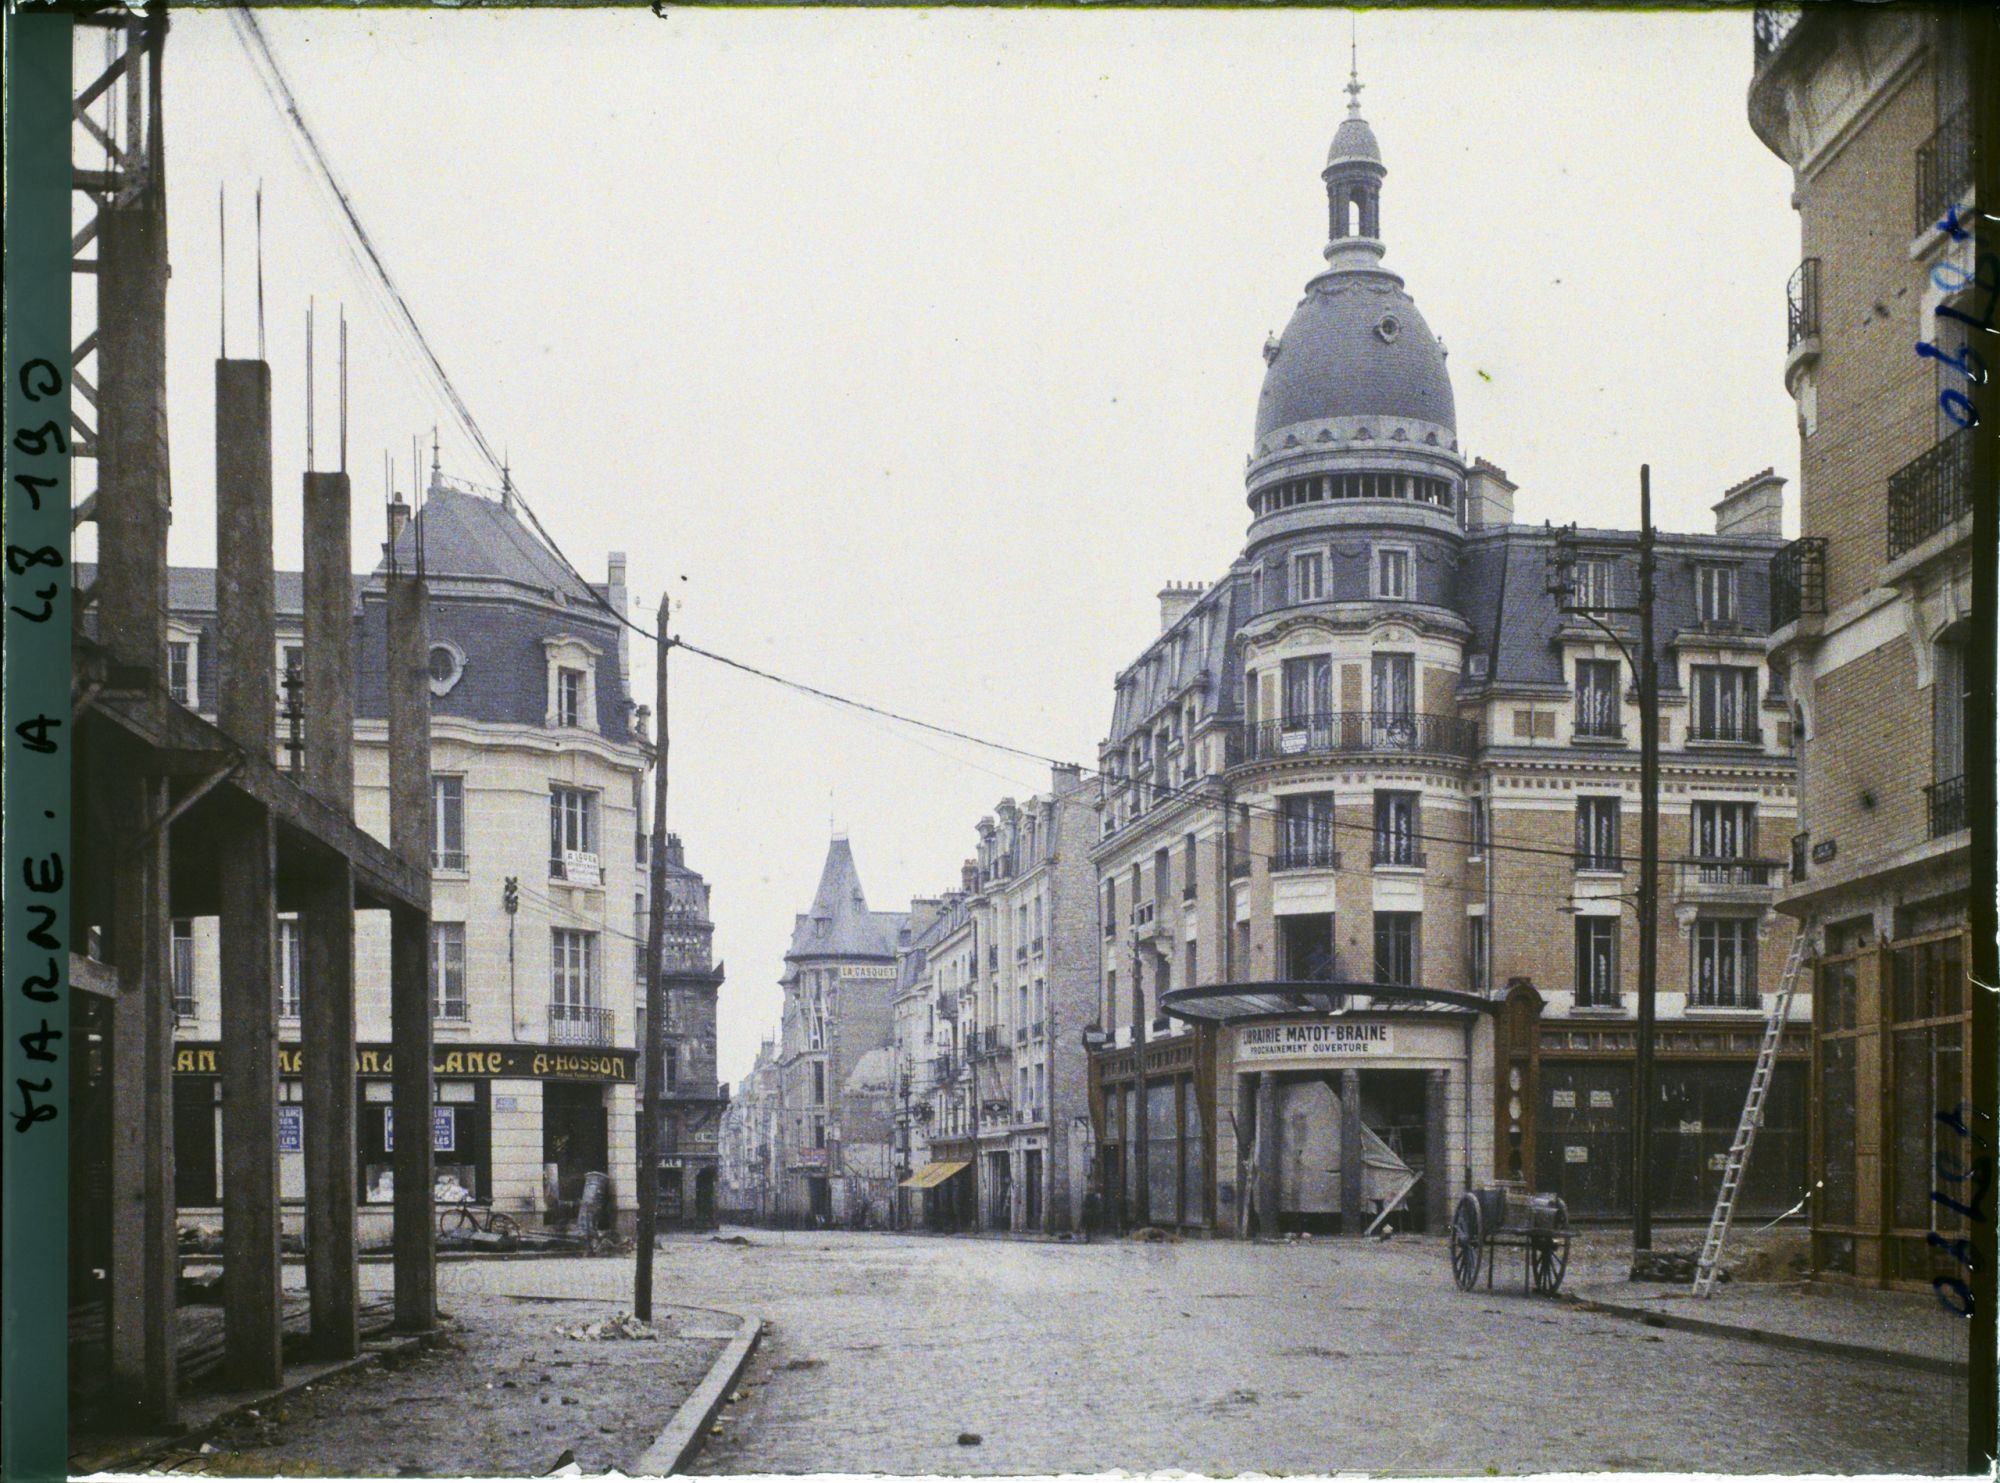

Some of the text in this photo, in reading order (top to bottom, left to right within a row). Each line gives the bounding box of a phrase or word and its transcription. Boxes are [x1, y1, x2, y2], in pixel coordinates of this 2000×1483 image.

[15, 714, 62, 754] A
[1242, 1025, 1386, 1045] LIBRAIRIE MATOT-BRAINE
[1250, 1043, 1369, 1055] PROCHAINEMENT OUVERTURE
